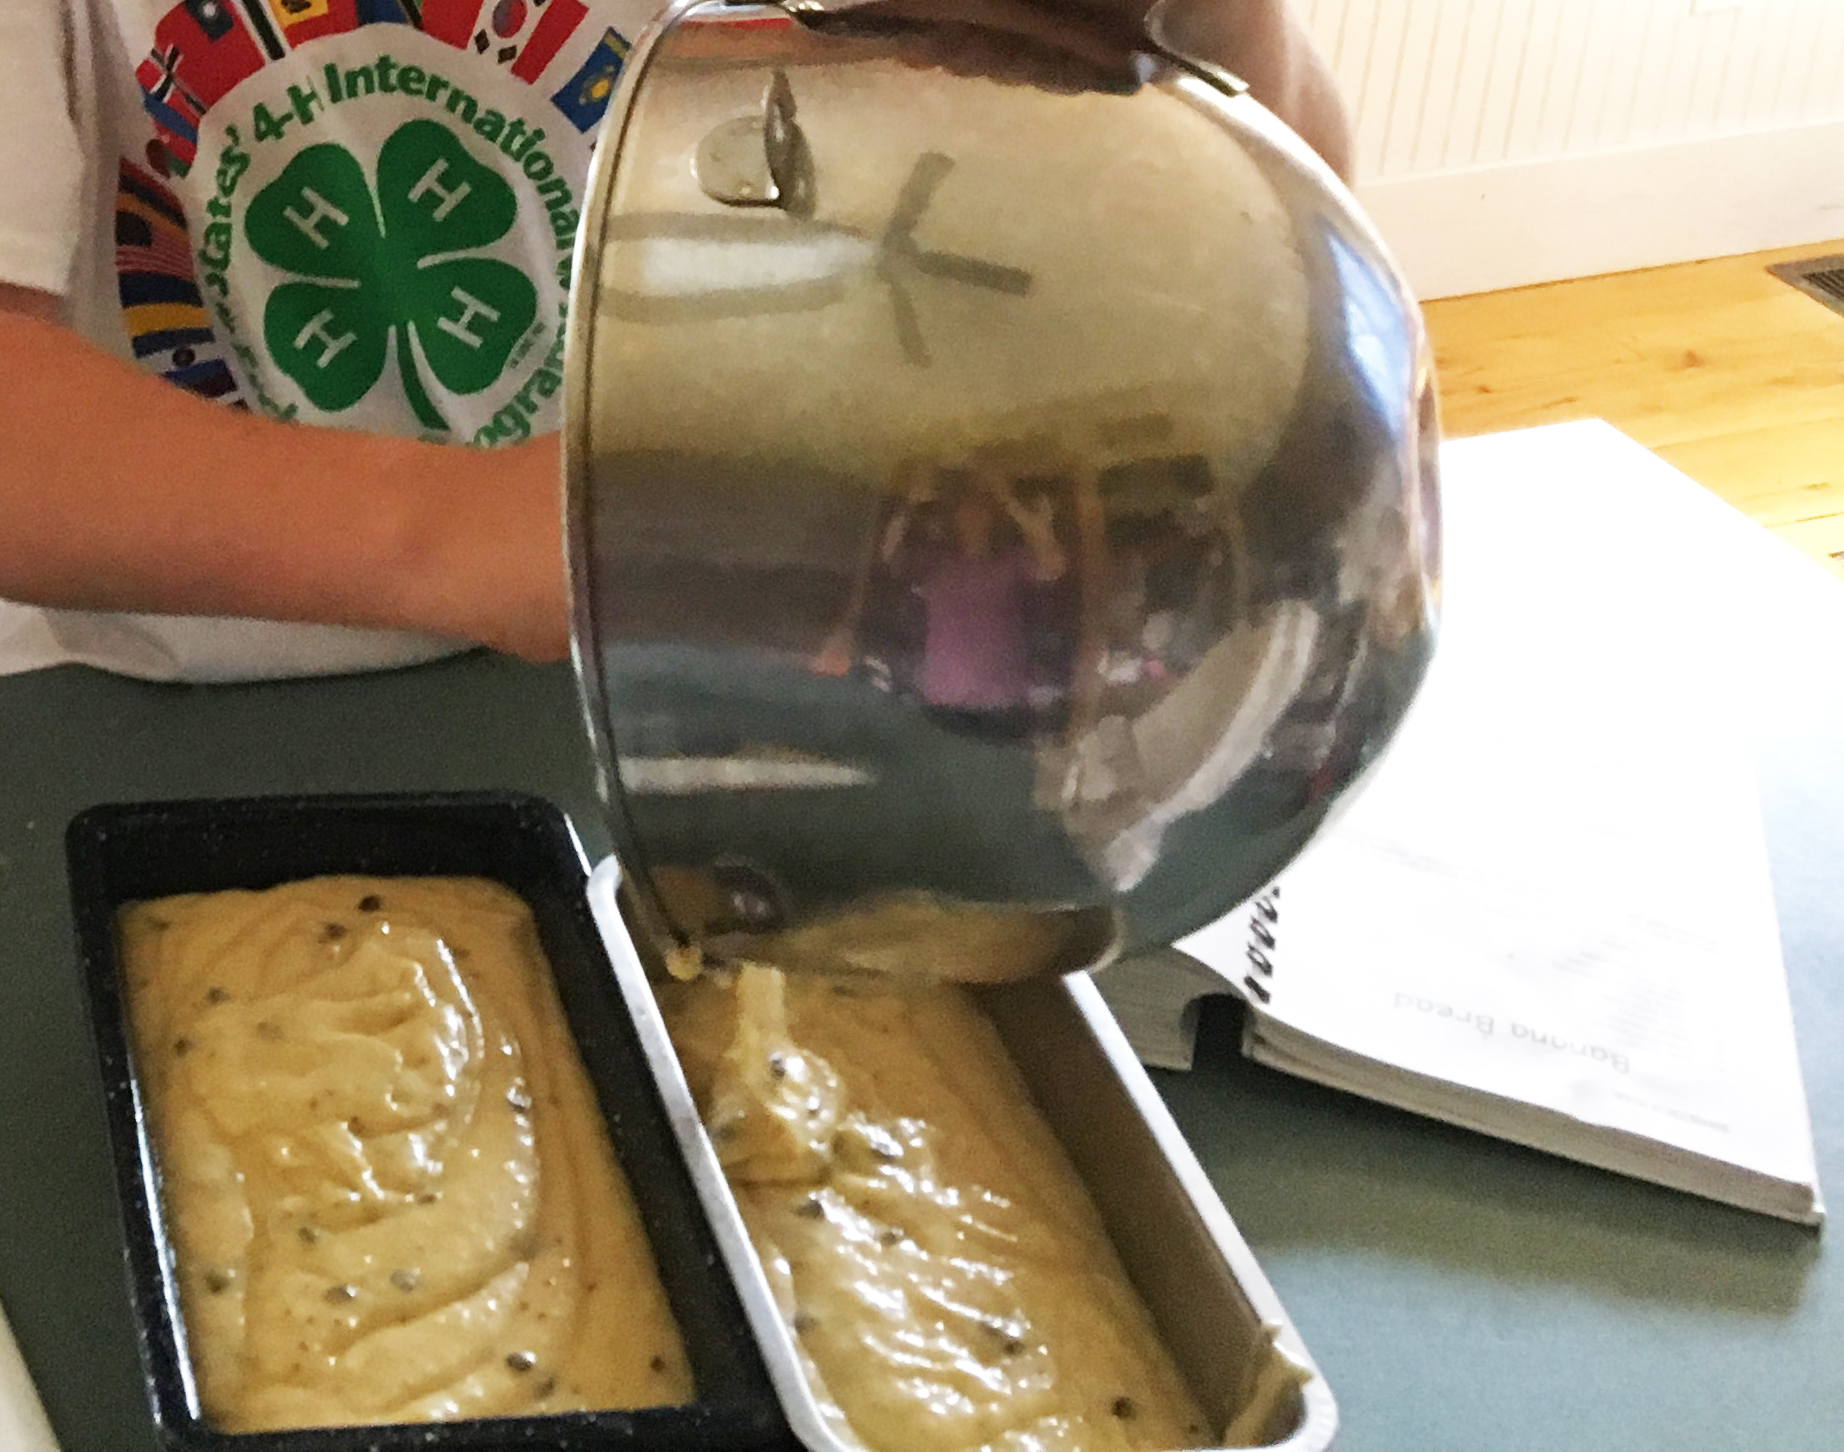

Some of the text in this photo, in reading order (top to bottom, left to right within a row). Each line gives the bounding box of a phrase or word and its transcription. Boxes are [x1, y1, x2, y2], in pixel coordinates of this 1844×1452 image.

[283, 186, 349, 249] H
[408, 158, 472, 222] H
[293, 309, 358, 369] H
[437, 286, 501, 350] H
[1392, 991, 1631, 1076] Banana Bread
